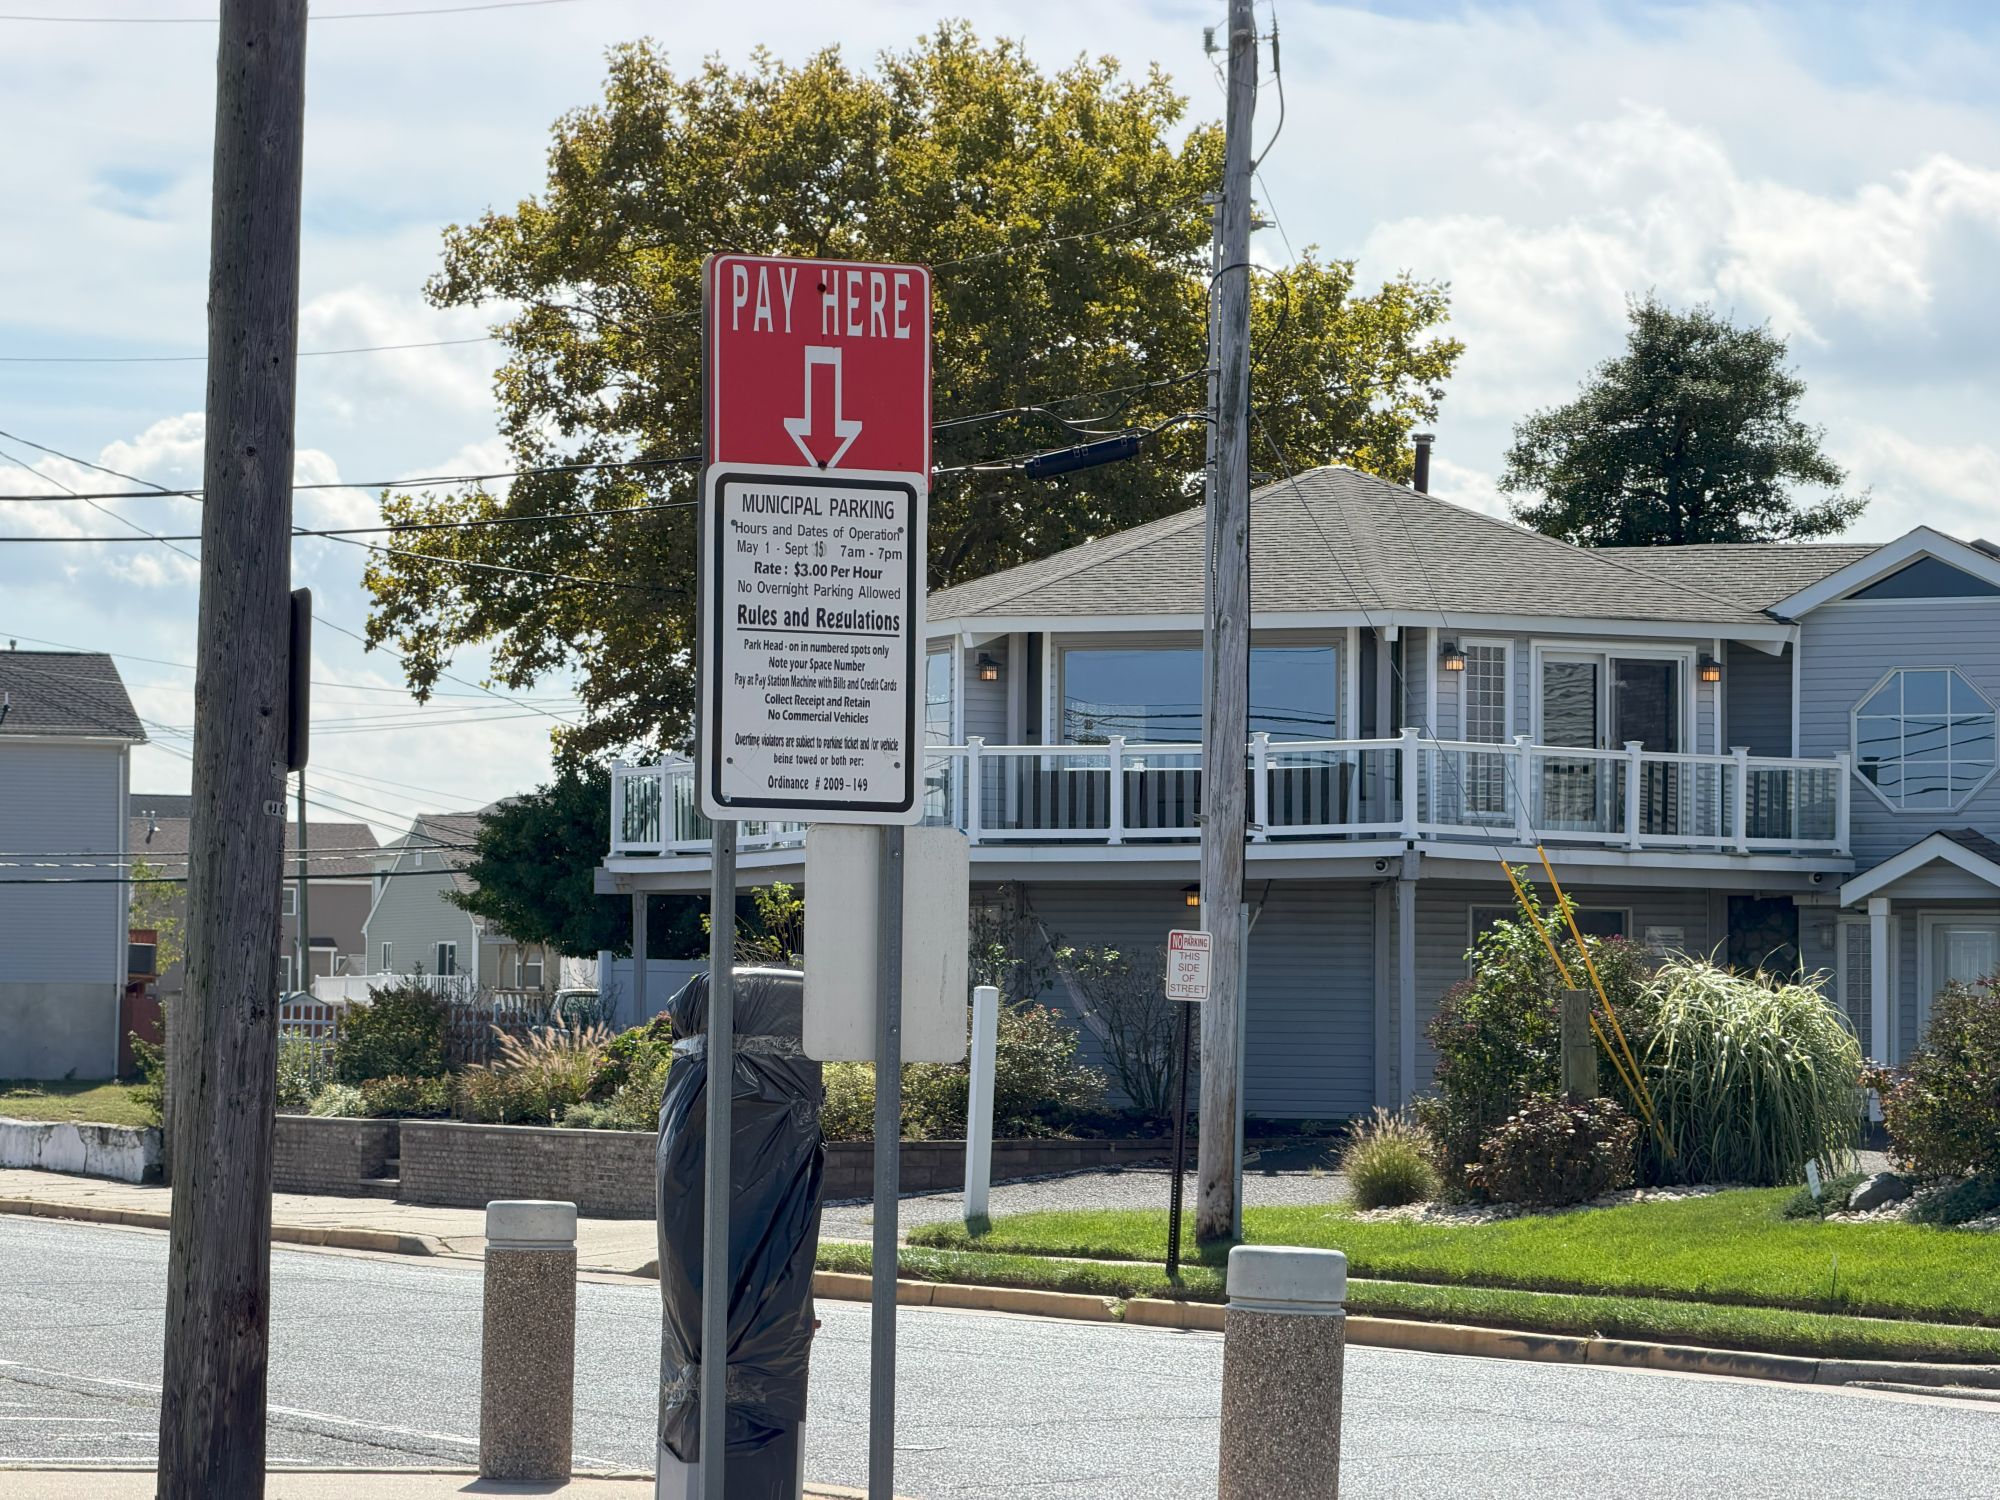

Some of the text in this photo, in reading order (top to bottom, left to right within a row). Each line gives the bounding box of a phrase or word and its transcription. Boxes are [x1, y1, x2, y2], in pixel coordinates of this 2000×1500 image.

[732, 265, 911, 339] PAY HERE
[742, 494, 894, 519] MUNICIPAL PARKING
[735, 522, 900, 541] Hours and Dates of Operation
[737, 540, 758, 555] May
[765, 542, 769, 553] 1
[785, 542, 808, 558] Sept
[814, 541, 824, 558] 15
[841, 545, 865, 558] 7am
[878, 548, 902, 562] 7pm
[794, 562, 828, 577] $3.00
[830, 565, 850, 578] Per
[853, 566, 883, 579] Hour
[737, 580, 900, 600] No Overnight Parking Allowed
[737, 605, 900, 631] Rules and Regulations
[744, 639, 761, 650] Park
[801, 641, 808, 651] in
[810, 643, 849, 654] numbered
[850, 645, 870, 656] spots
[873, 645, 889, 658] only
[769, 657, 865, 673] Note your Space Number
[735, 673, 897, 691] Pay at Pay Station Machine with Bills and Credit Cards
[765, 693, 871, 709] Collect Receipt and Retain
[768, 709, 869, 723] No Commercial Vehicles
[735, 732, 759, 747] Overtime
[761, 733, 784, 747] violators
[786, 737, 794, 747] are
[796, 736, 815, 749] subject
[816, 737, 822, 747] to
[823, 737, 843, 750] parking
[844, 737, 858, 749] ticket
[860, 738, 869, 749] and
[880, 739, 898, 751] vehicle
[774, 753, 864, 767] being towed or both per:
[768, 775, 809, 790] Ordinance
[815, 777, 820, 790] #
[1173, 934, 1207, 949] NO PARKING
[1179, 952, 1200, 960] THIS
[1178, 963, 1200, 972] SIDE
[1182, 974, 1195, 982] OF
[1170, 984, 1206, 993] STREET
